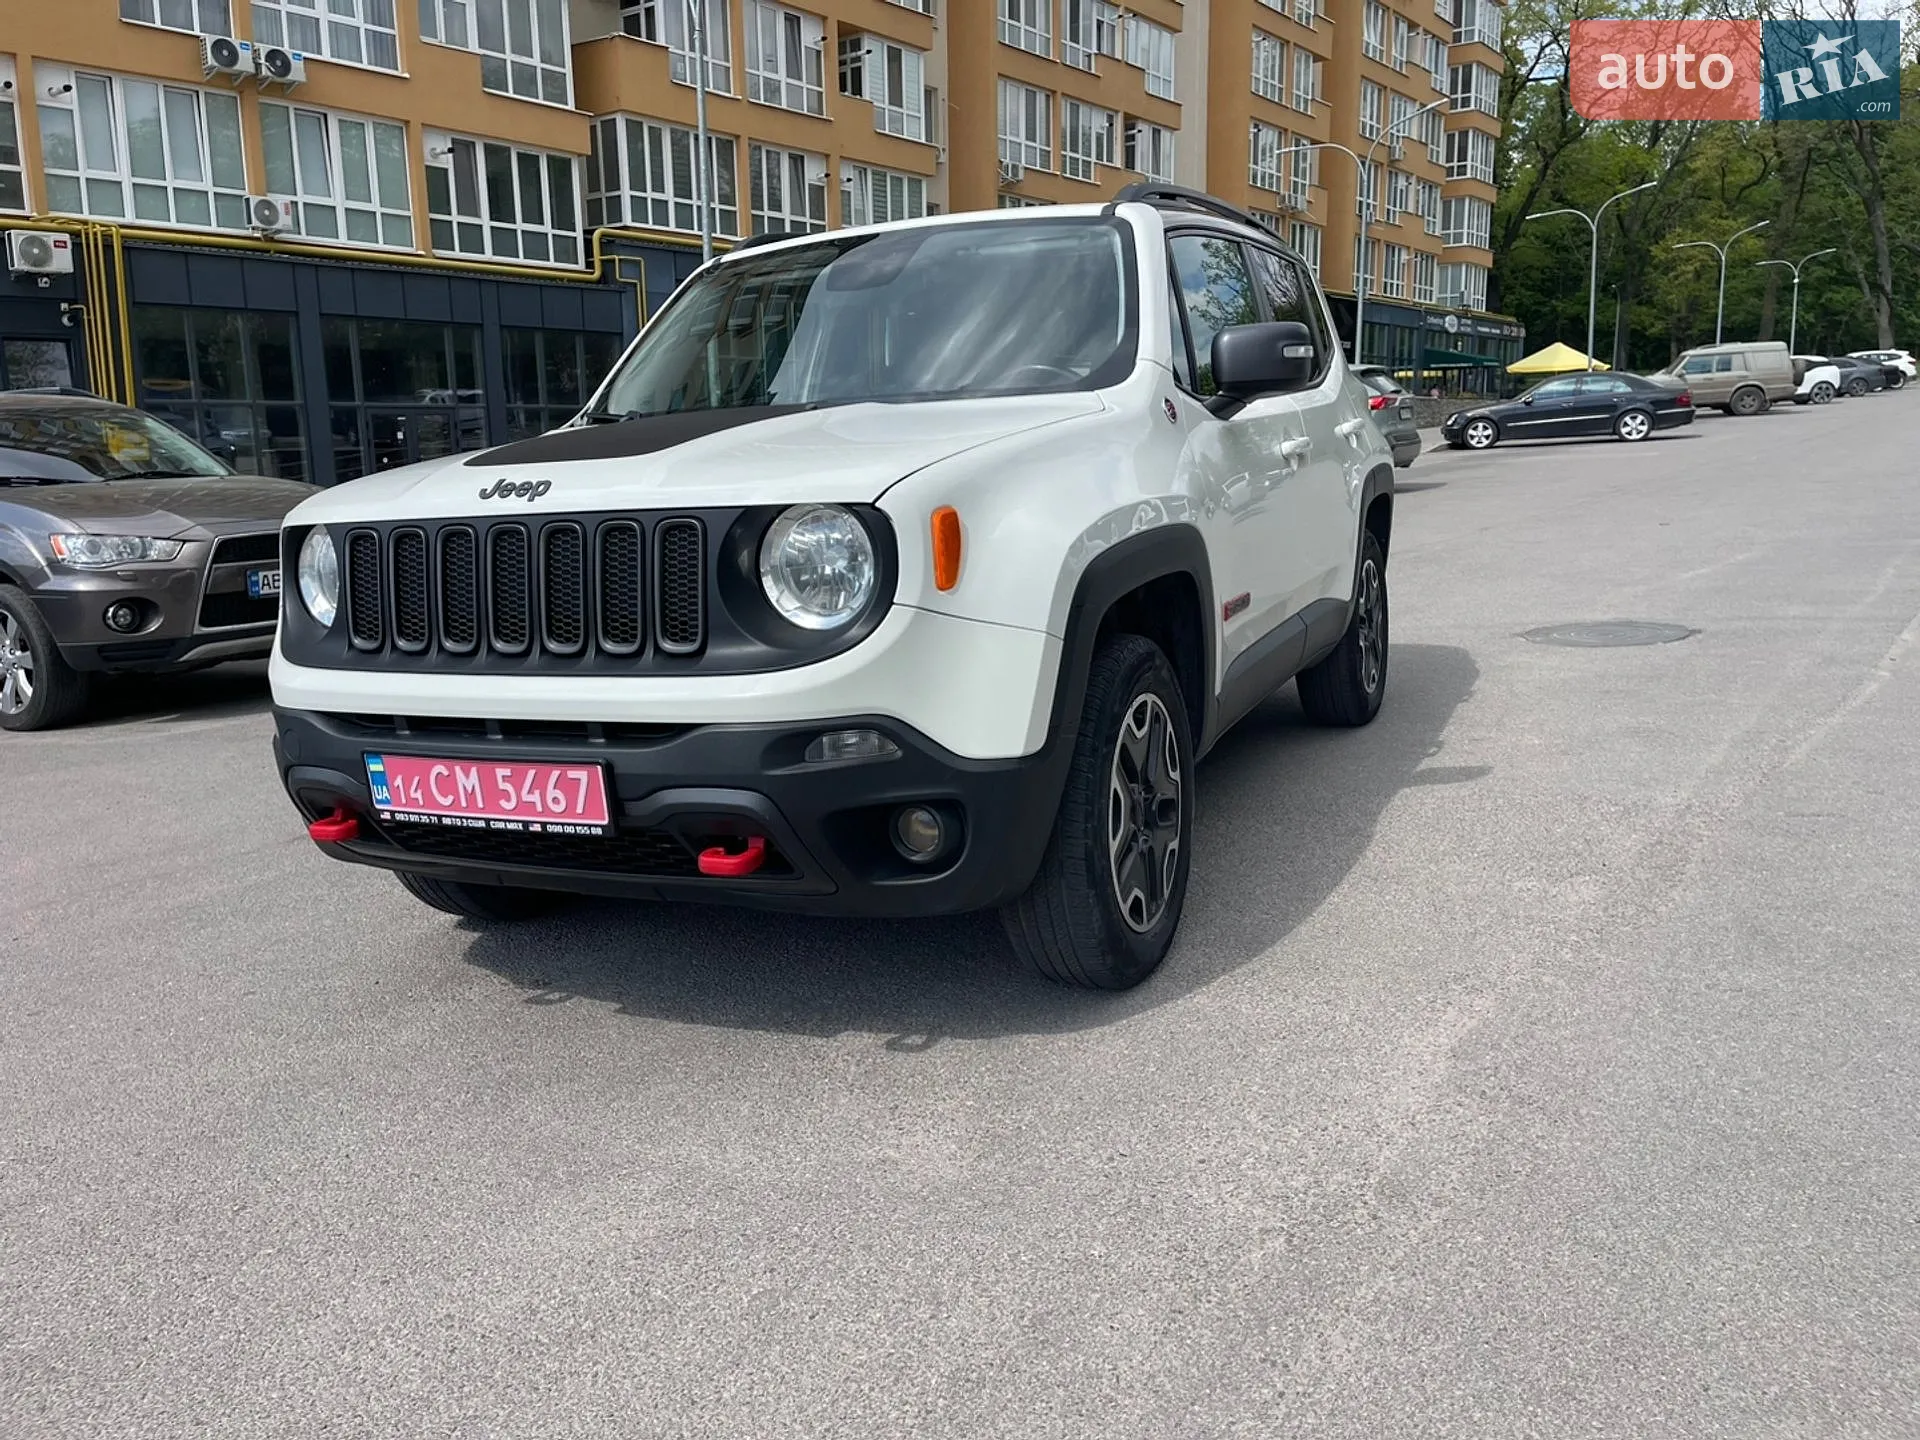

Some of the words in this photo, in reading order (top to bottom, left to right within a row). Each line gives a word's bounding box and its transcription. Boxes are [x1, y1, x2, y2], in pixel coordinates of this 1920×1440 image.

[478, 478, 552, 502] Jeep
[373, 783, 391, 800] UA
[393, 774, 424, 806] 14
[429, 764, 484, 809] CM
[495, 768, 589, 814] 5467
